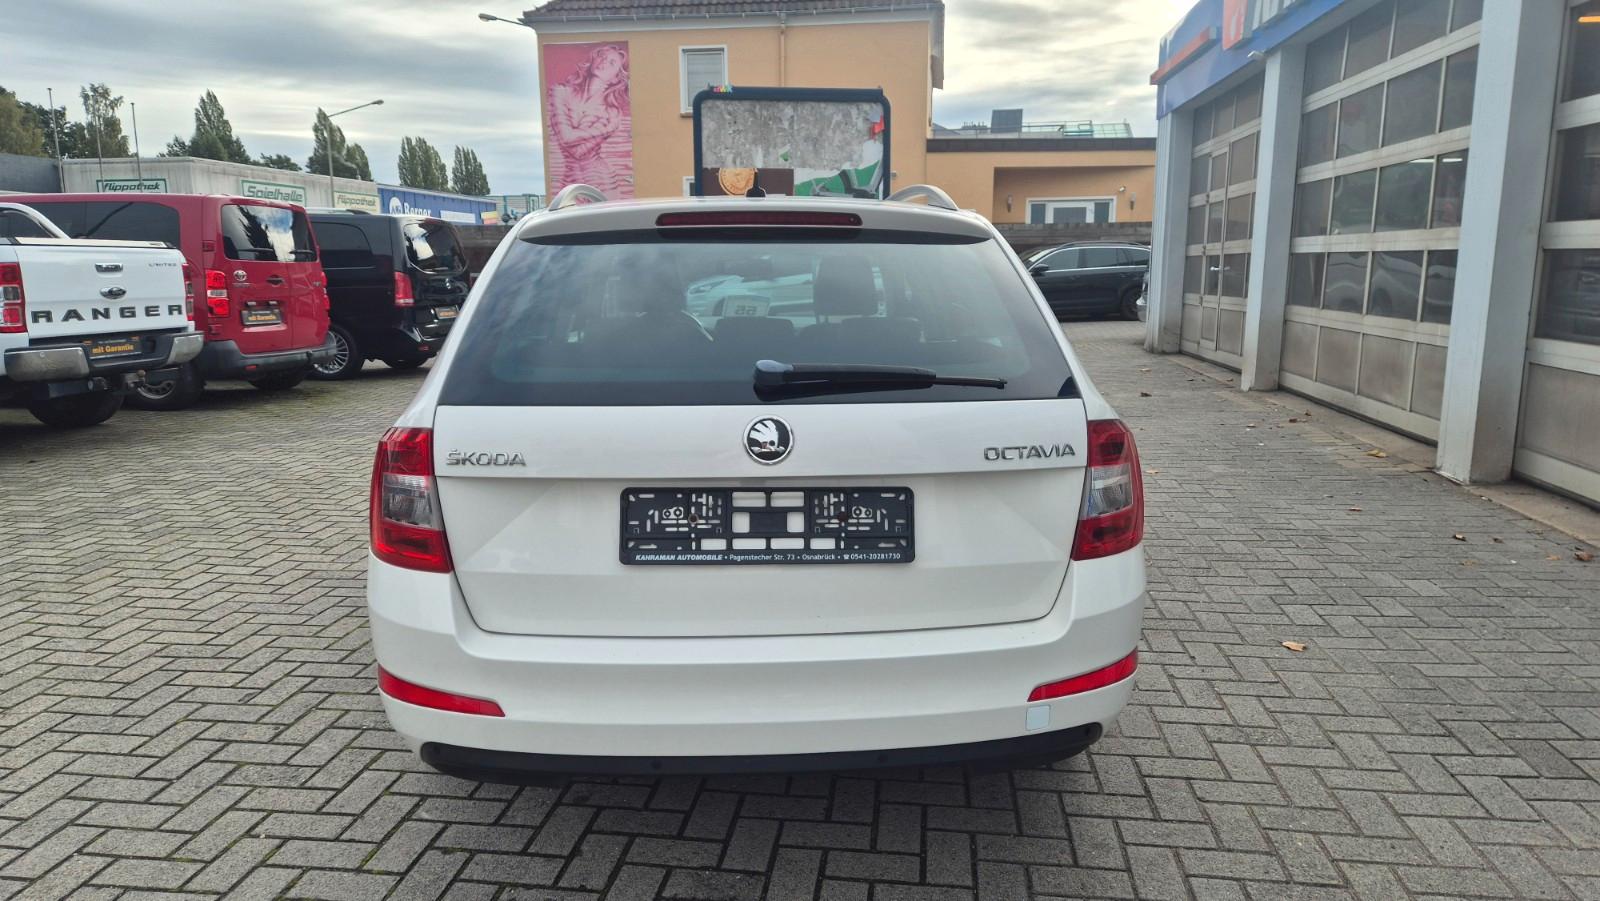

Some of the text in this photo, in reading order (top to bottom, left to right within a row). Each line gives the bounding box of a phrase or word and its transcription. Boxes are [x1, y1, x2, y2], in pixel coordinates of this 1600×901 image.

[247, 185, 303, 202] Spielhalle
[31, 304, 183, 323] RANGER
[92, 344, 134, 354] mit Garantie
[446, 448, 526, 466] ŠKODA
[983, 443, 1076, 461] OCTAVIA
[729, 554, 771, 562] Pagenstecher
